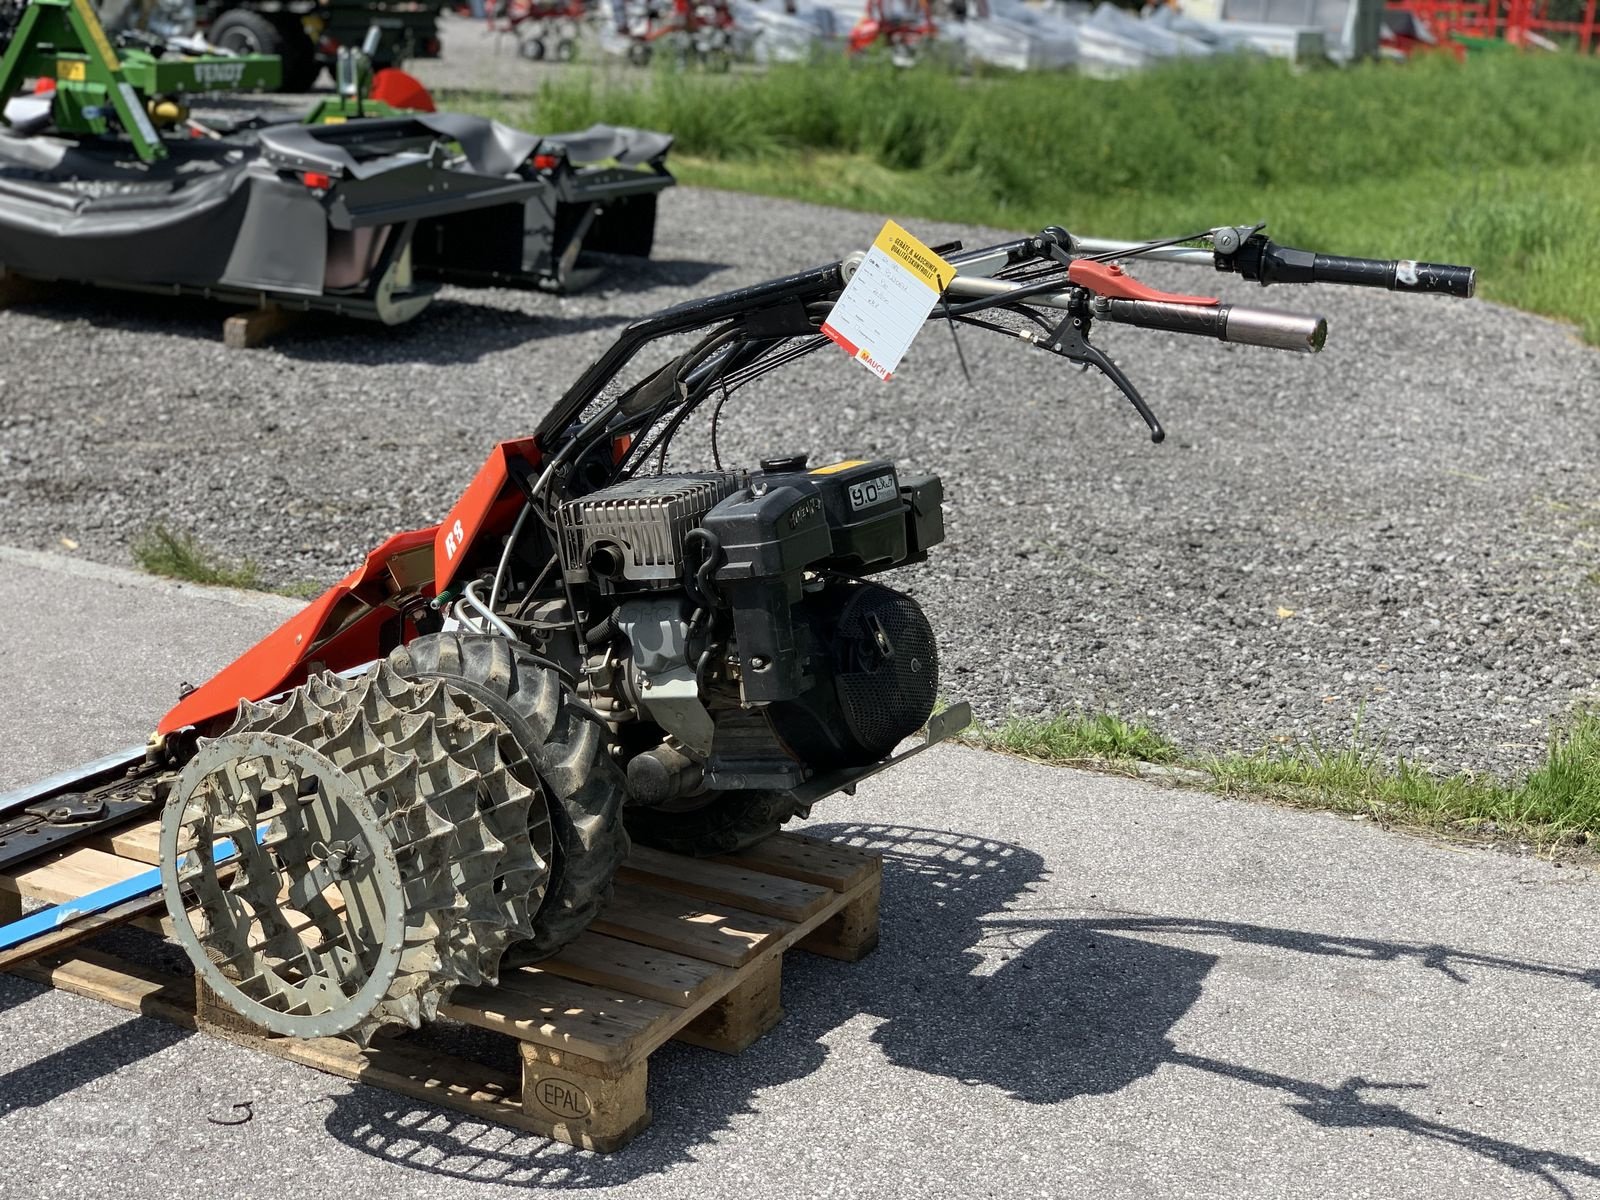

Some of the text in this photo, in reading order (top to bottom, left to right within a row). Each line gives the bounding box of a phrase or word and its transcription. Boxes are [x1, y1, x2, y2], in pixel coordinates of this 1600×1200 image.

[890, 245, 934, 280] QUALITÄTSKONTROLLE
[894, 237, 910, 253] GERÄTE
[914, 251, 938, 274] MASCHINEN
[860, 352, 886, 376] MAUCH
[852, 485, 878, 507] 9.0
[445, 519, 464, 561] R8
[544, 1084, 584, 1114] EPAL
